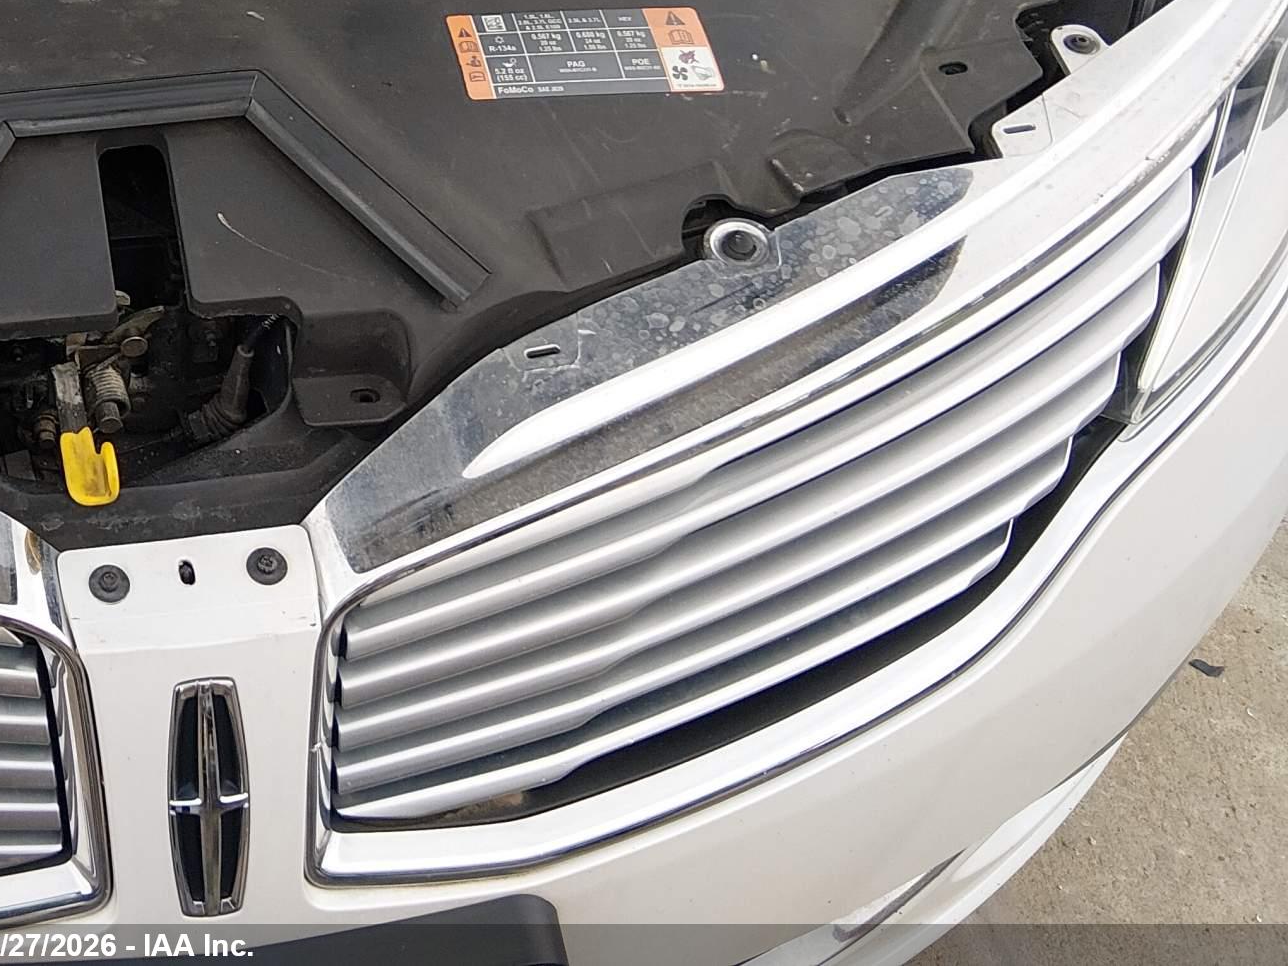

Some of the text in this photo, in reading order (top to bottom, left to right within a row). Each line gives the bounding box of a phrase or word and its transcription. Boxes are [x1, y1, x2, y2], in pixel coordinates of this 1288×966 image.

[488, 44, 517, 52] R-134a
[567, 60, 586, 68] PAG
[497, 85, 535, 94] FoMoCo
